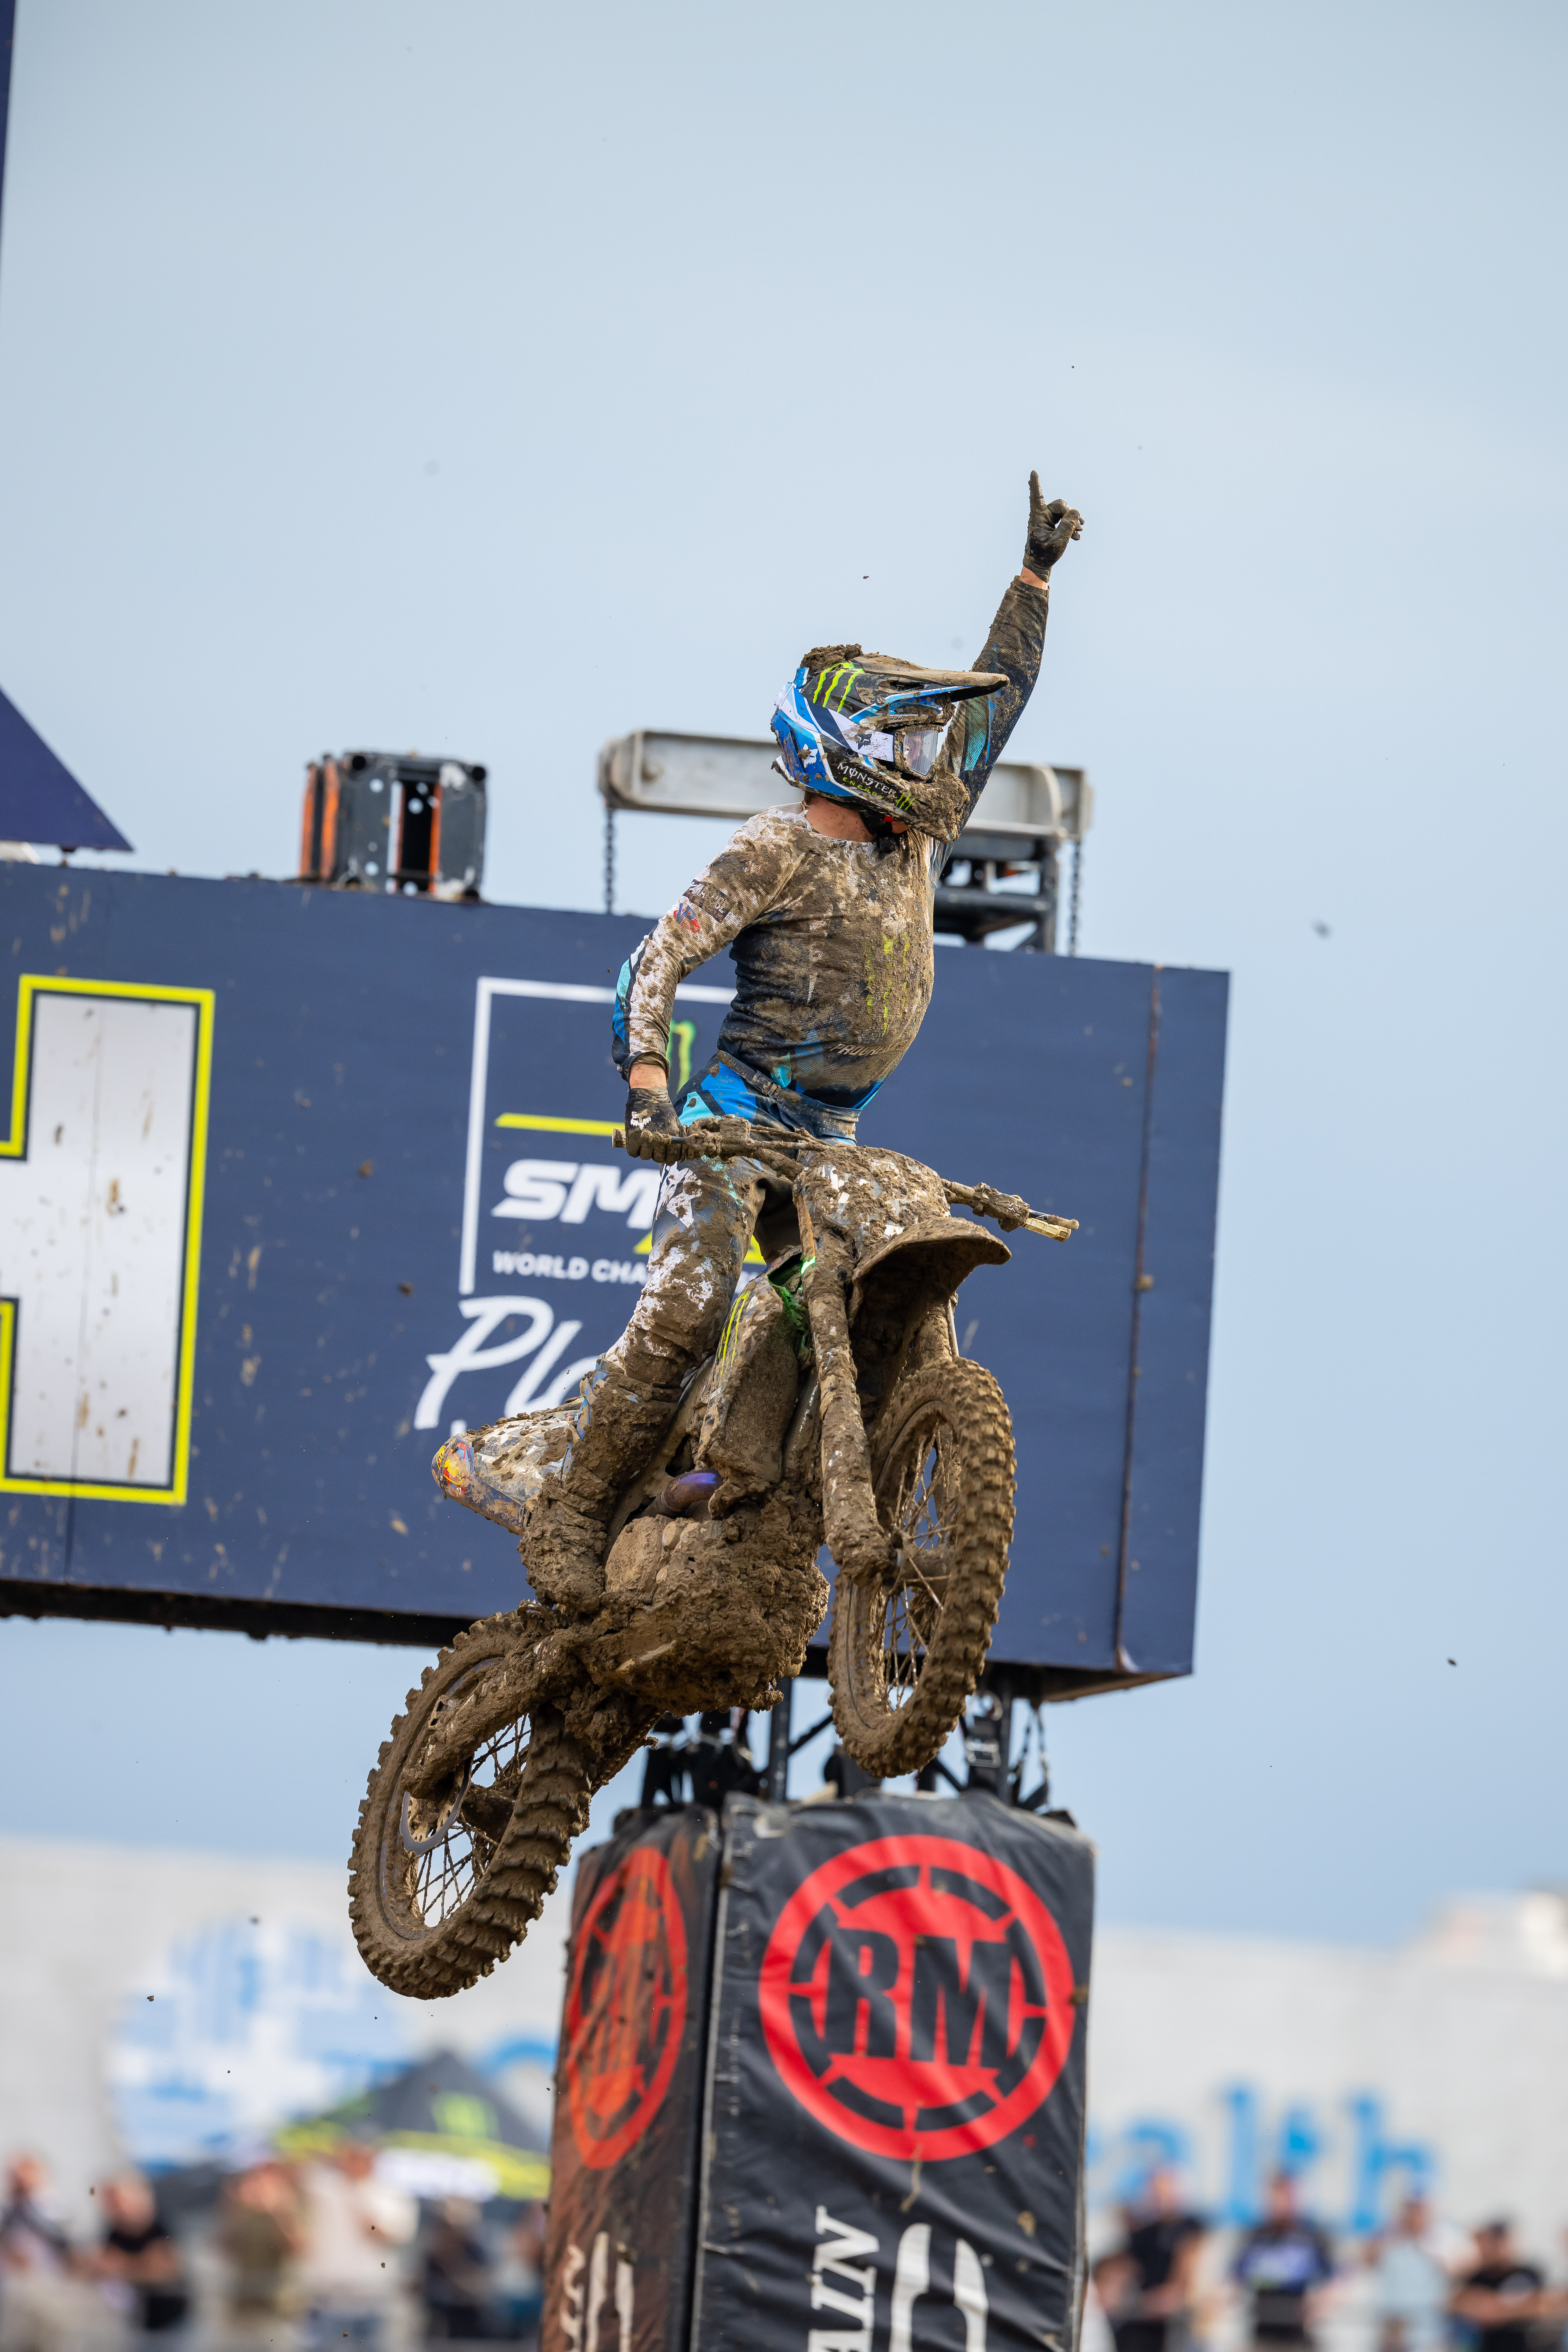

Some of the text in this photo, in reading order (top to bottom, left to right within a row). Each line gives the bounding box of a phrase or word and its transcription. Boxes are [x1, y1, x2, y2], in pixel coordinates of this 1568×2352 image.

[837, 763, 897, 798] MONSTER
[491, 1159, 661, 1230] SM
[493, 1250, 589, 1280] WORLD
[821, 1927, 1017, 2070] RM
